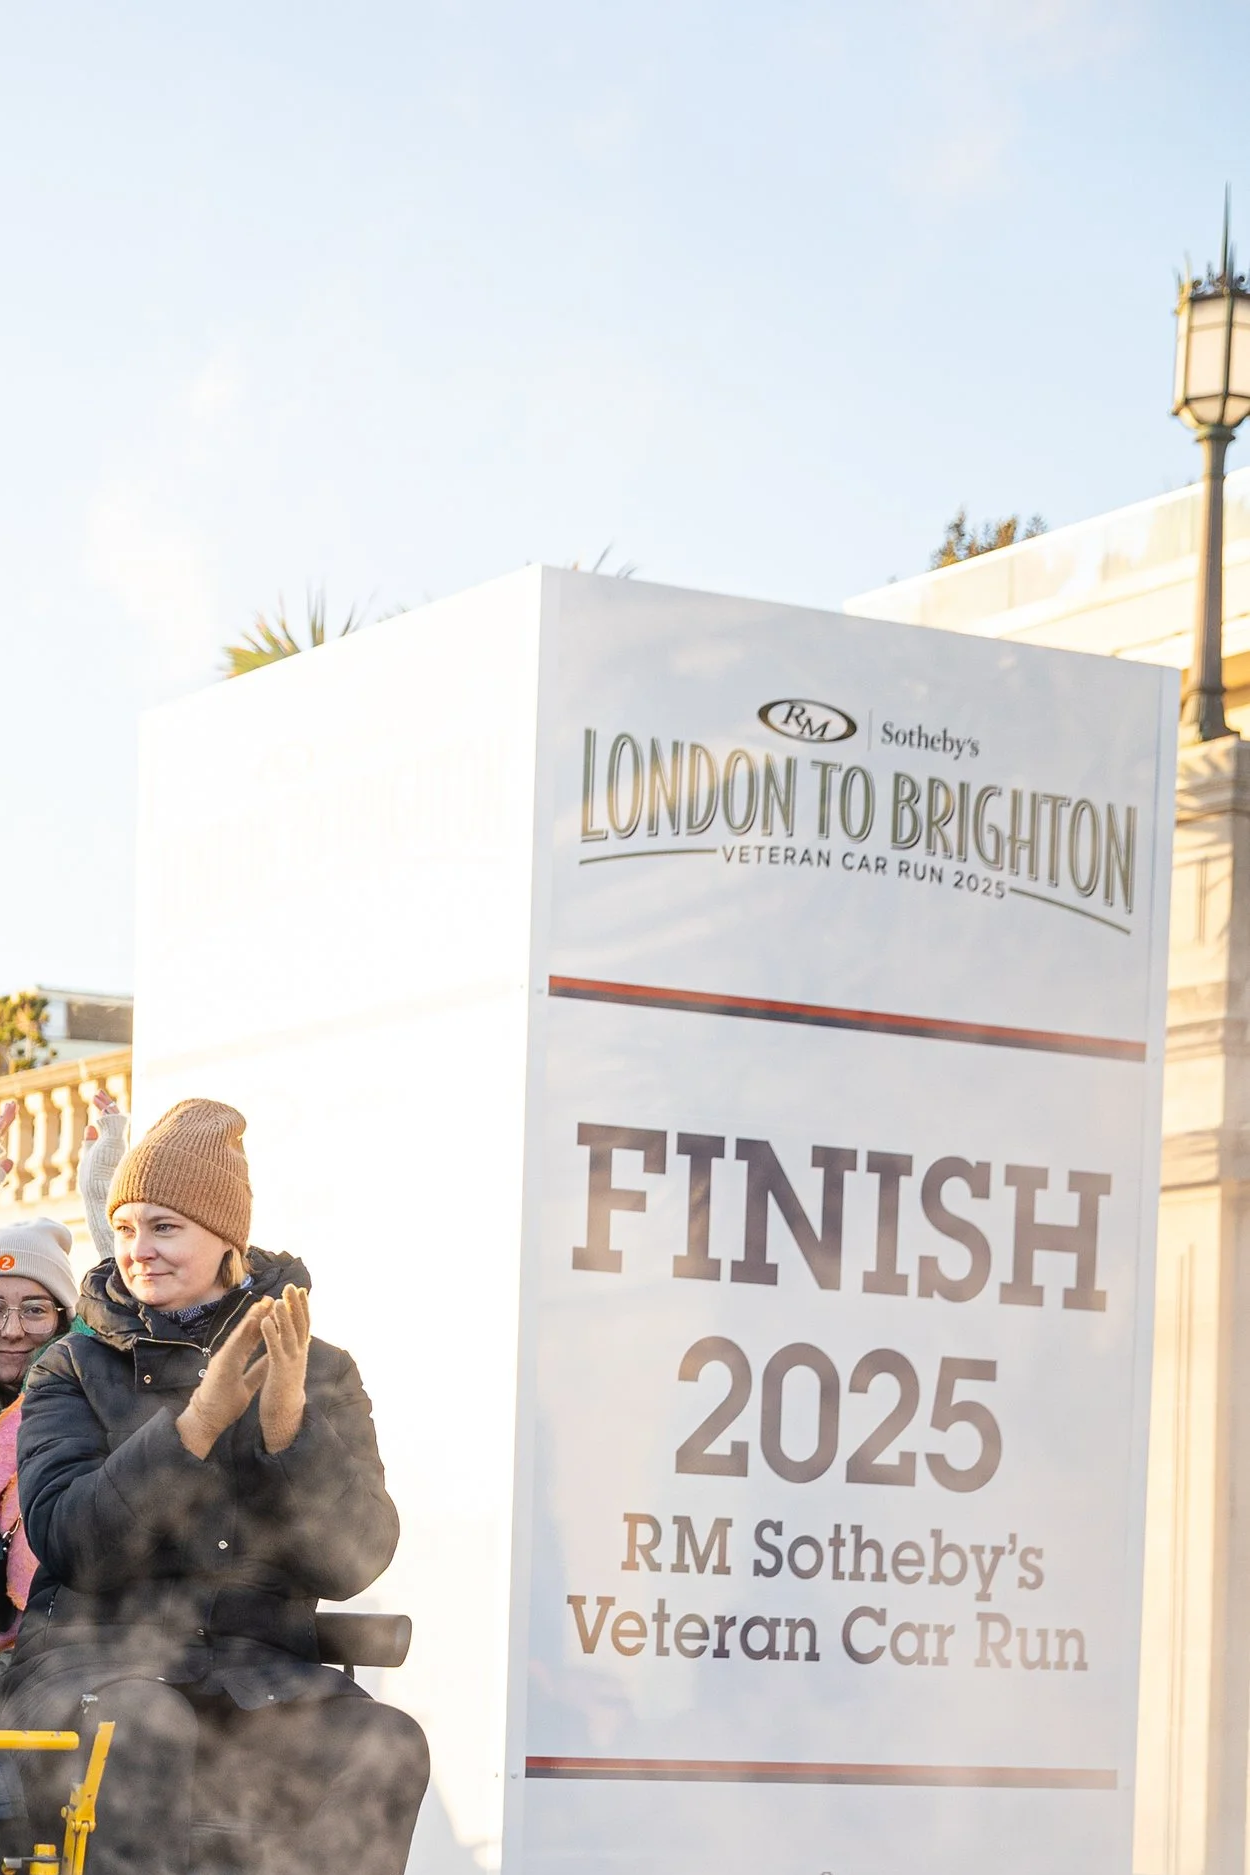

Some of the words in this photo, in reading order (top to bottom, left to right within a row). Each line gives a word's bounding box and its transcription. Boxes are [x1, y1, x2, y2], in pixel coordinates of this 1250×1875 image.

[781, 704, 833, 739] RM
[880, 720, 981, 758] Sotheby's
[580, 727, 798, 842] LONDON
[810, 759, 875, 843] TO
[890, 771, 1138, 914] BRIGHTON
[721, 844, 831, 869] VETERAN
[841, 852, 888, 877] CAR
[898, 860, 943, 885] RUN
[953, 870, 1007, 899] 2025
[571, 1121, 1112, 1313] FINISH
[1, 1256, 11, 1269] 2
[675, 1335, 1003, 1493] 2025
[620, 1511, 734, 1577] RM
[752, 1518, 1045, 1603] Sotheby's
[566, 1594, 821, 1662] Veteran
[841, 1605, 956, 1665] Car
[973, 1611, 1089, 1673] Run
